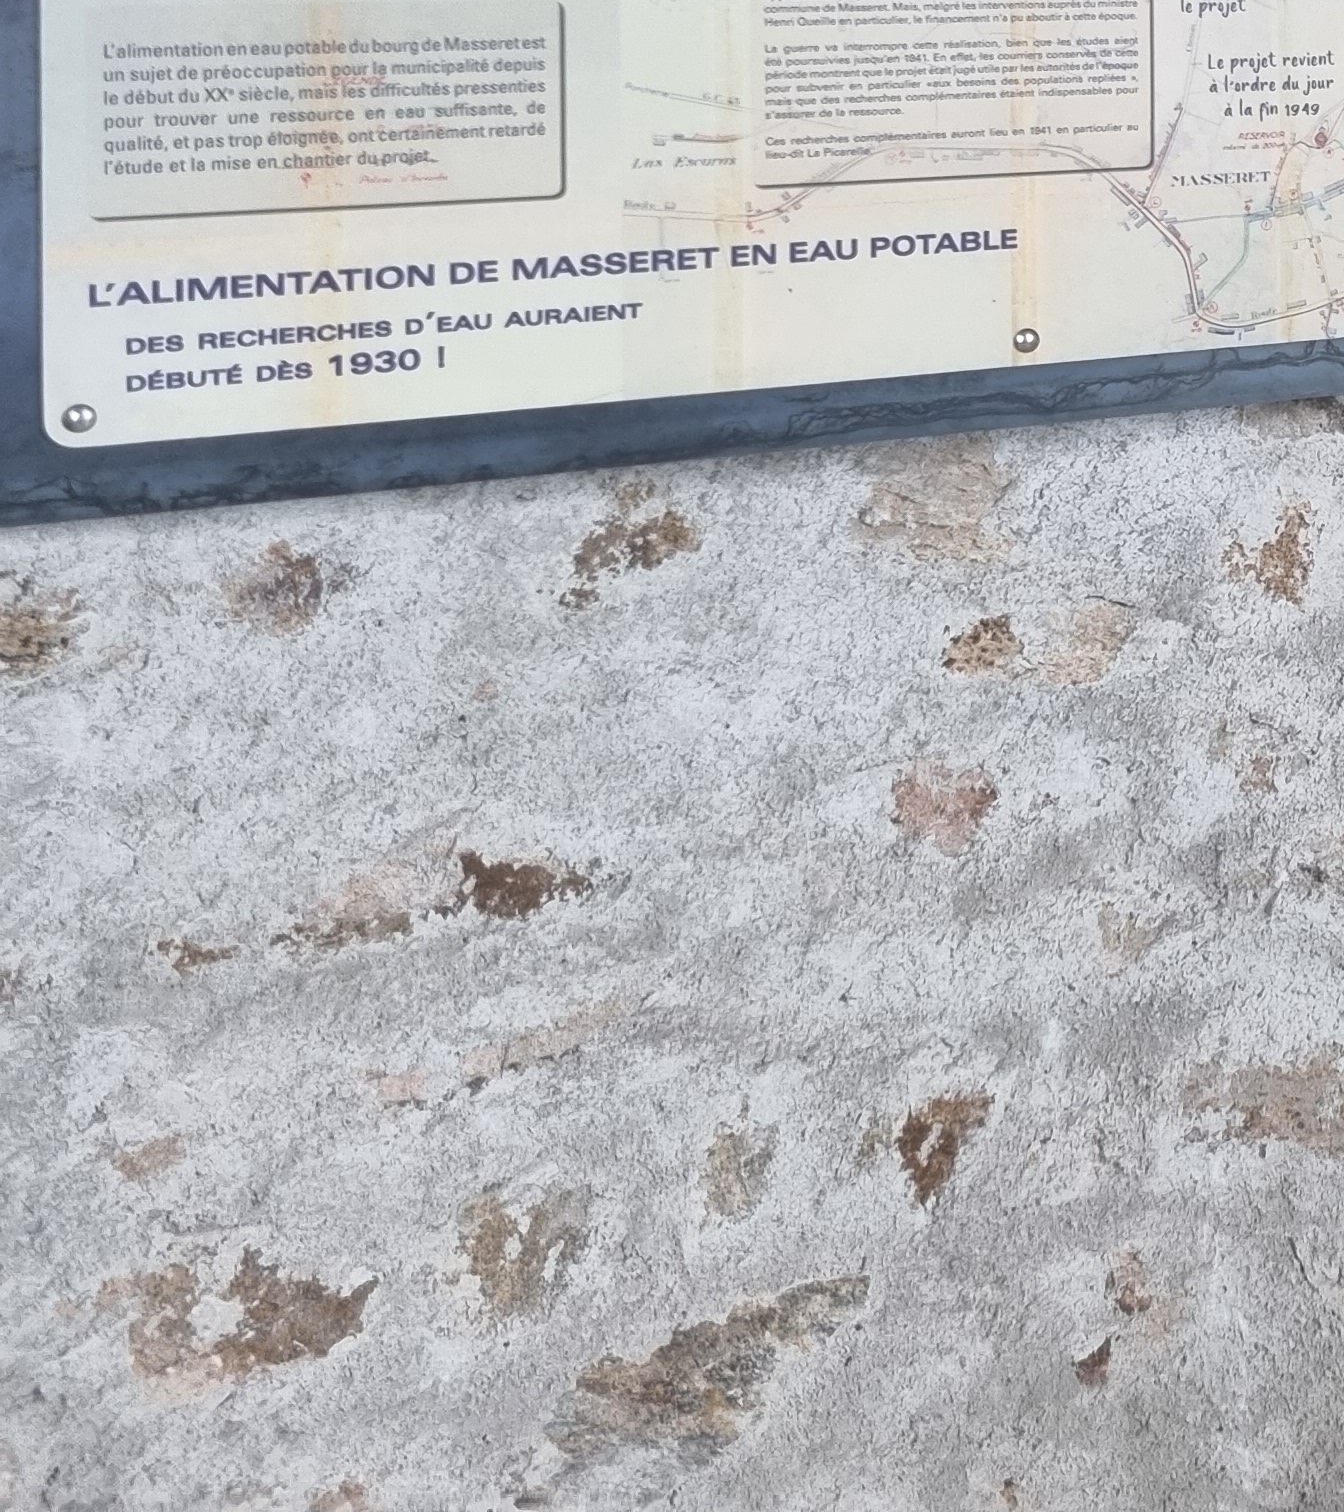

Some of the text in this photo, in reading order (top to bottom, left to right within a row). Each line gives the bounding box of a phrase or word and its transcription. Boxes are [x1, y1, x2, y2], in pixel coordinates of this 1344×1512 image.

[104, 36, 546, 59] L'alimentation en eau potable du bourg de Masseret est
[104, 70, 125, 82] un
[130, 66, 172, 84] sujet
[178, 66, 197, 81] de
[203, 62, 326, 82] préoccupation
[331, 64, 368, 78] pour
[372, 61, 387, 75] la
[392, 58, 489, 75] municipalité
[494, 57, 546, 74] depuis
[1208, 50, 1334, 74] Le projet revient
[104, 91, 118, 105] le
[124, 90, 173, 105] début
[178, 89, 199, 103] du
[239, 87, 294, 103] siècle,
[299, 87, 337, 100] mais
[343, 84, 366, 98] les
[371, 82, 450, 97] difficultés
[454, 80, 546, 97] pressenties
[1209, 74, 1334, 95] à l'ordre du jour
[104, 101, 546, 131] pour trouver une ressource en eau suffisante, de
[1224, 98, 1319, 122] à la fin 1949
[104, 122, 546, 154] qualité, et pas trop éloignée, ont certainement retardé
[104, 159, 163, 175] l'étude
[169, 160, 186, 173] et
[191, 158, 205, 172] la
[212, 156, 250, 171] mise
[257, 157, 277, 169] en
[284, 153, 352, 169] chantier
[357, 150, 377, 165] du
[1171, 171, 1270, 187] MASSERET
[88, 228, 1017, 307] L'ALIMENTATION DE MASSERET EN EAU POTABLE
[125, 302, 643, 355] DES RECHERCHES D'EAU AURAIENT
[126, 345, 445, 392] DÉBUTÉ DÈS 1930 !
